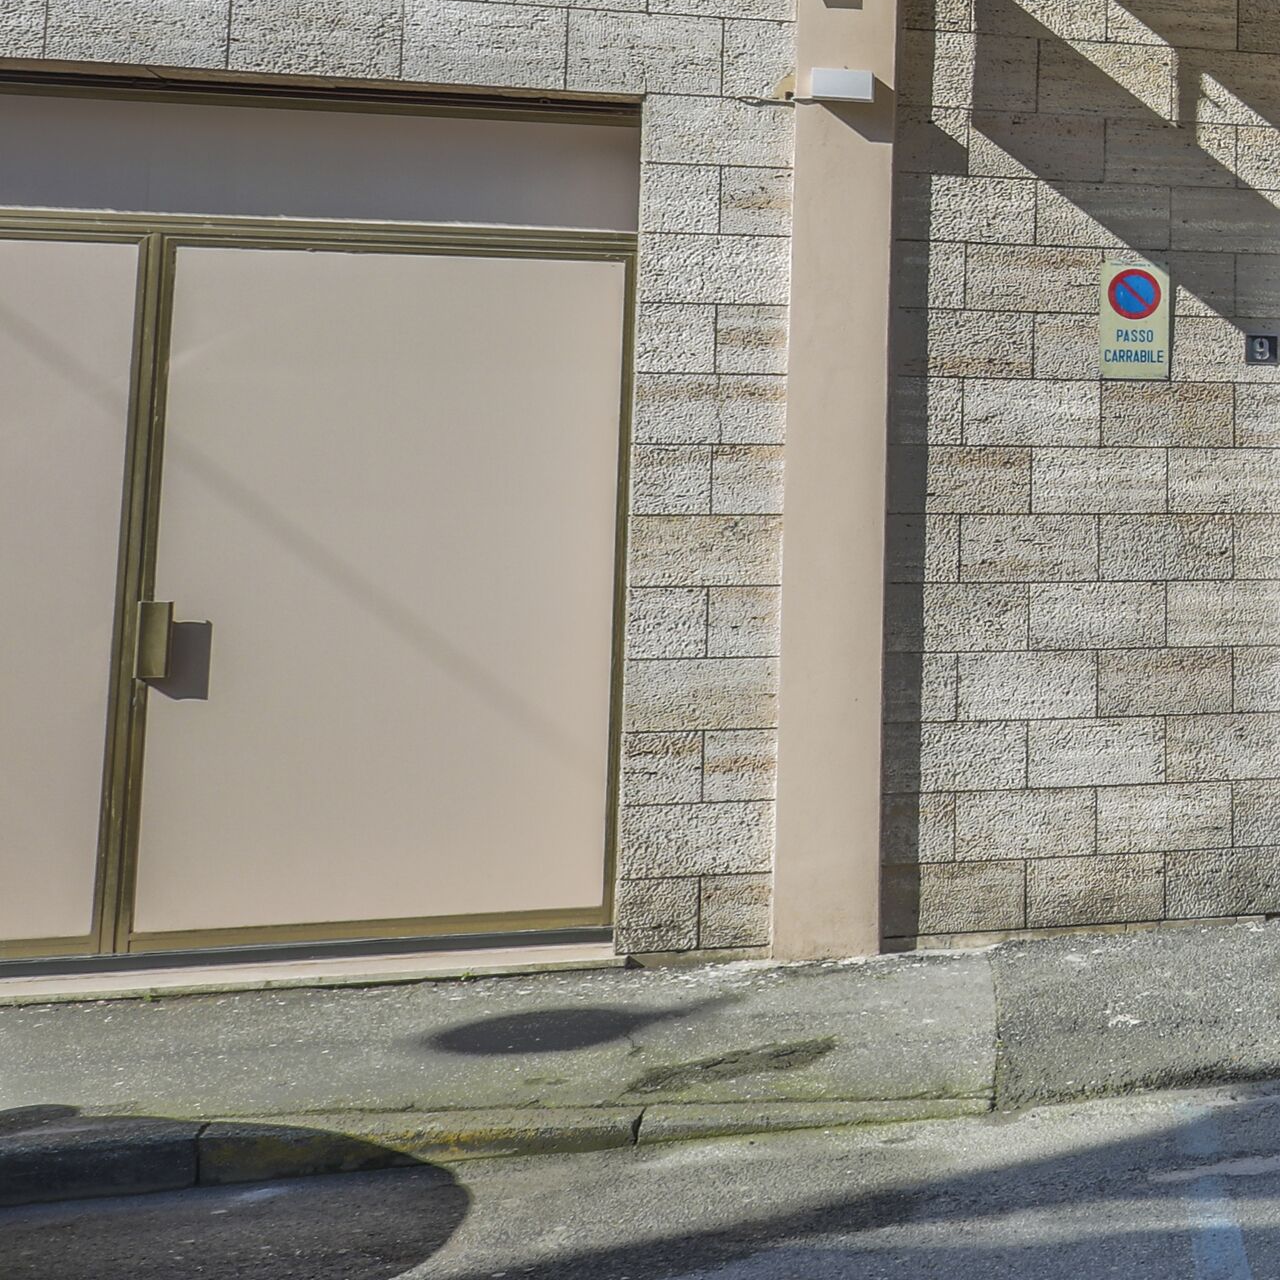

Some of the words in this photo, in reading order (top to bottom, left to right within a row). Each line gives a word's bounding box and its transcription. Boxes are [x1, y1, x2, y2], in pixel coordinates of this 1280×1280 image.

[1116, 329, 1154, 343] PASSO
[1104, 349, 1165, 364] CARRABILE
[1252, 337, 1271, 361] 9
